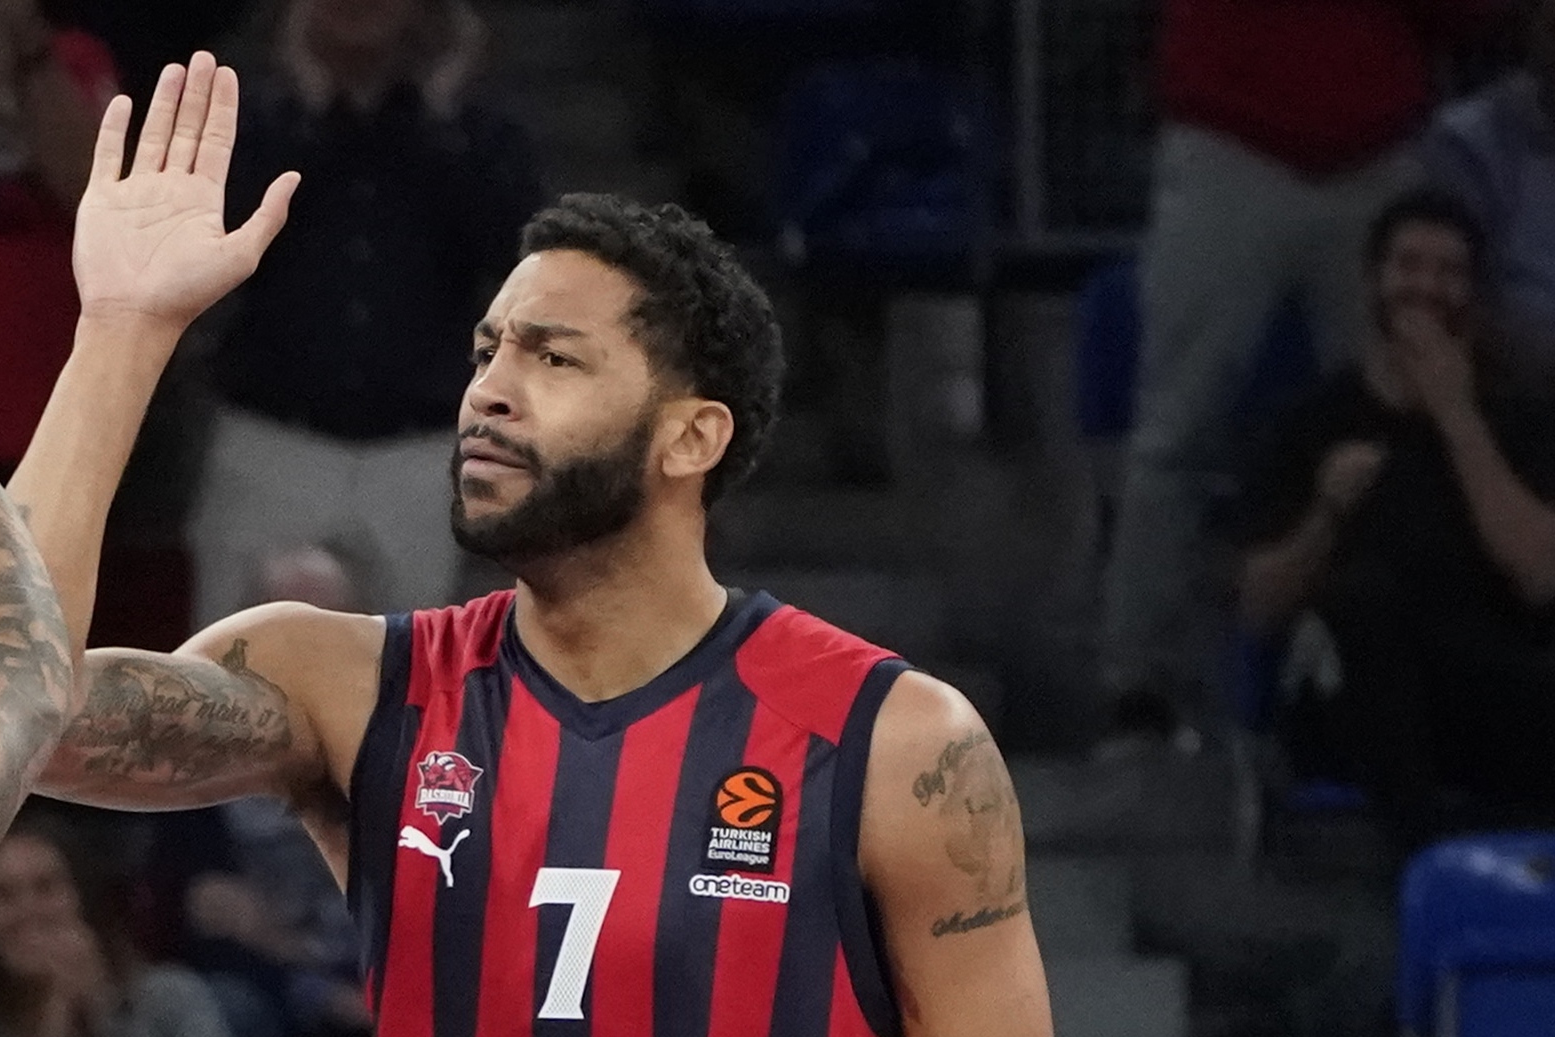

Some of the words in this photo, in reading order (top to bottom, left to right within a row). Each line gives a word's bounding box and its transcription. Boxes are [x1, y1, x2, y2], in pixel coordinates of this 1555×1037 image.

[710, 827, 772, 842] TURKISH
[708, 838, 770, 853] AIRLINES
[707, 849, 770, 865] EuroLeague
[691, 877, 788, 901] oneteam
[528, 867, 622, 1019] 7
